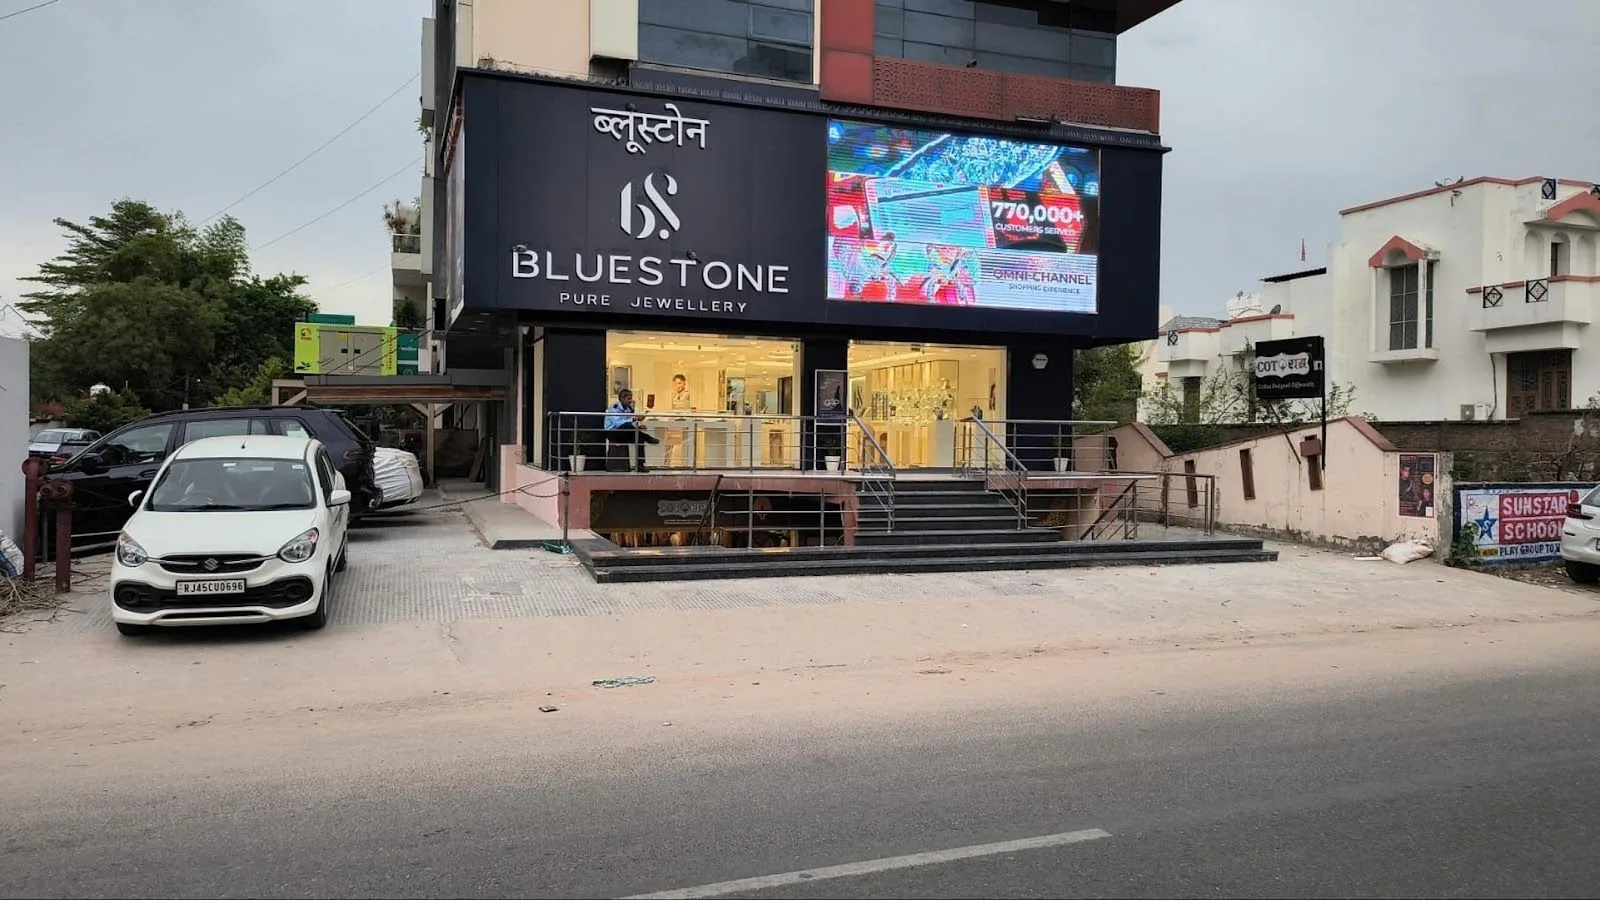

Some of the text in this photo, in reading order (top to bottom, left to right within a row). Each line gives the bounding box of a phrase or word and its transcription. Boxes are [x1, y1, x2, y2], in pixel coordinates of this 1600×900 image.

[591, 103, 710, 154] ब्लूस्टोन
[992, 201, 1084, 224] 770,000+
[995, 223, 1044, 233] CUSTOMERS
[512, 249, 790, 293] BLUESTONE
[560, 292, 748, 313] PURE JEWELLERY
[184, 582, 243, 592] RJ45CU0696
